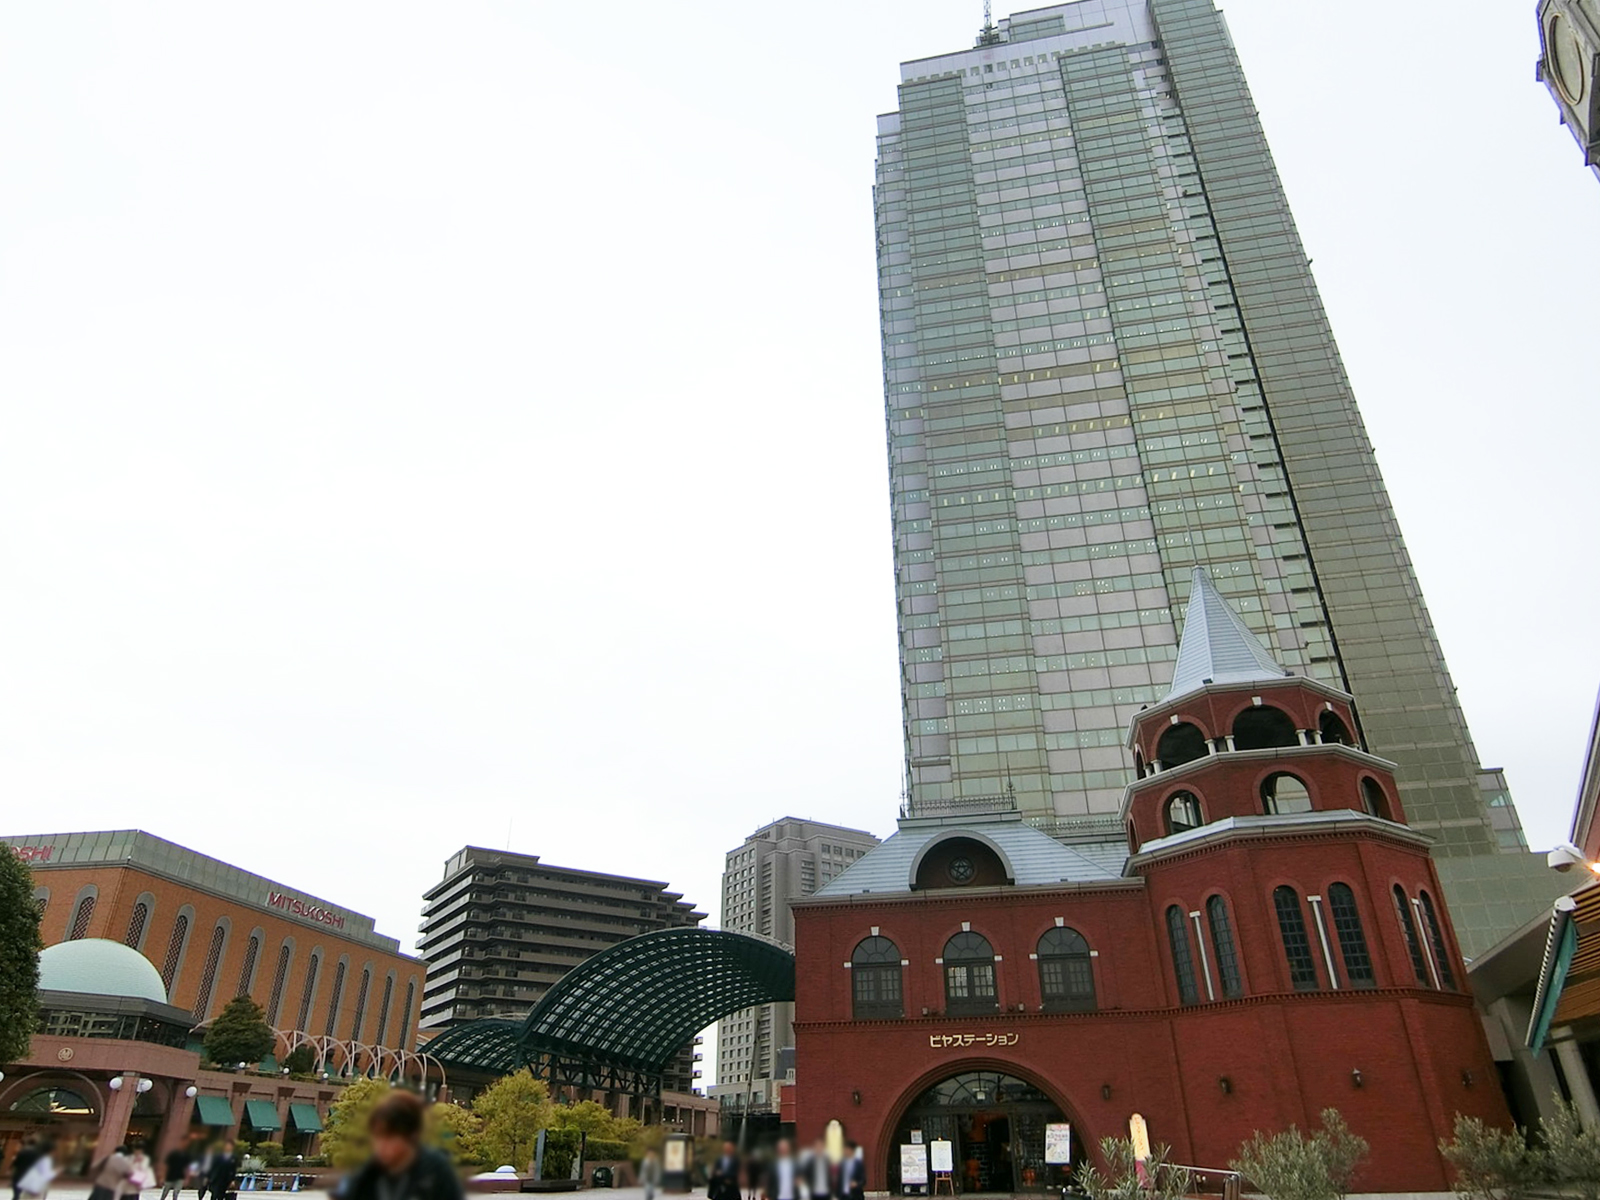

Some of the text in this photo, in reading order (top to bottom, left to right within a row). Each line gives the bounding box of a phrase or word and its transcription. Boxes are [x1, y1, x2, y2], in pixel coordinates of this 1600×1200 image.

[268, 891, 345, 929] MITSUKOSHI
[929, 1033, 1020, 1048] ビヤステーション
